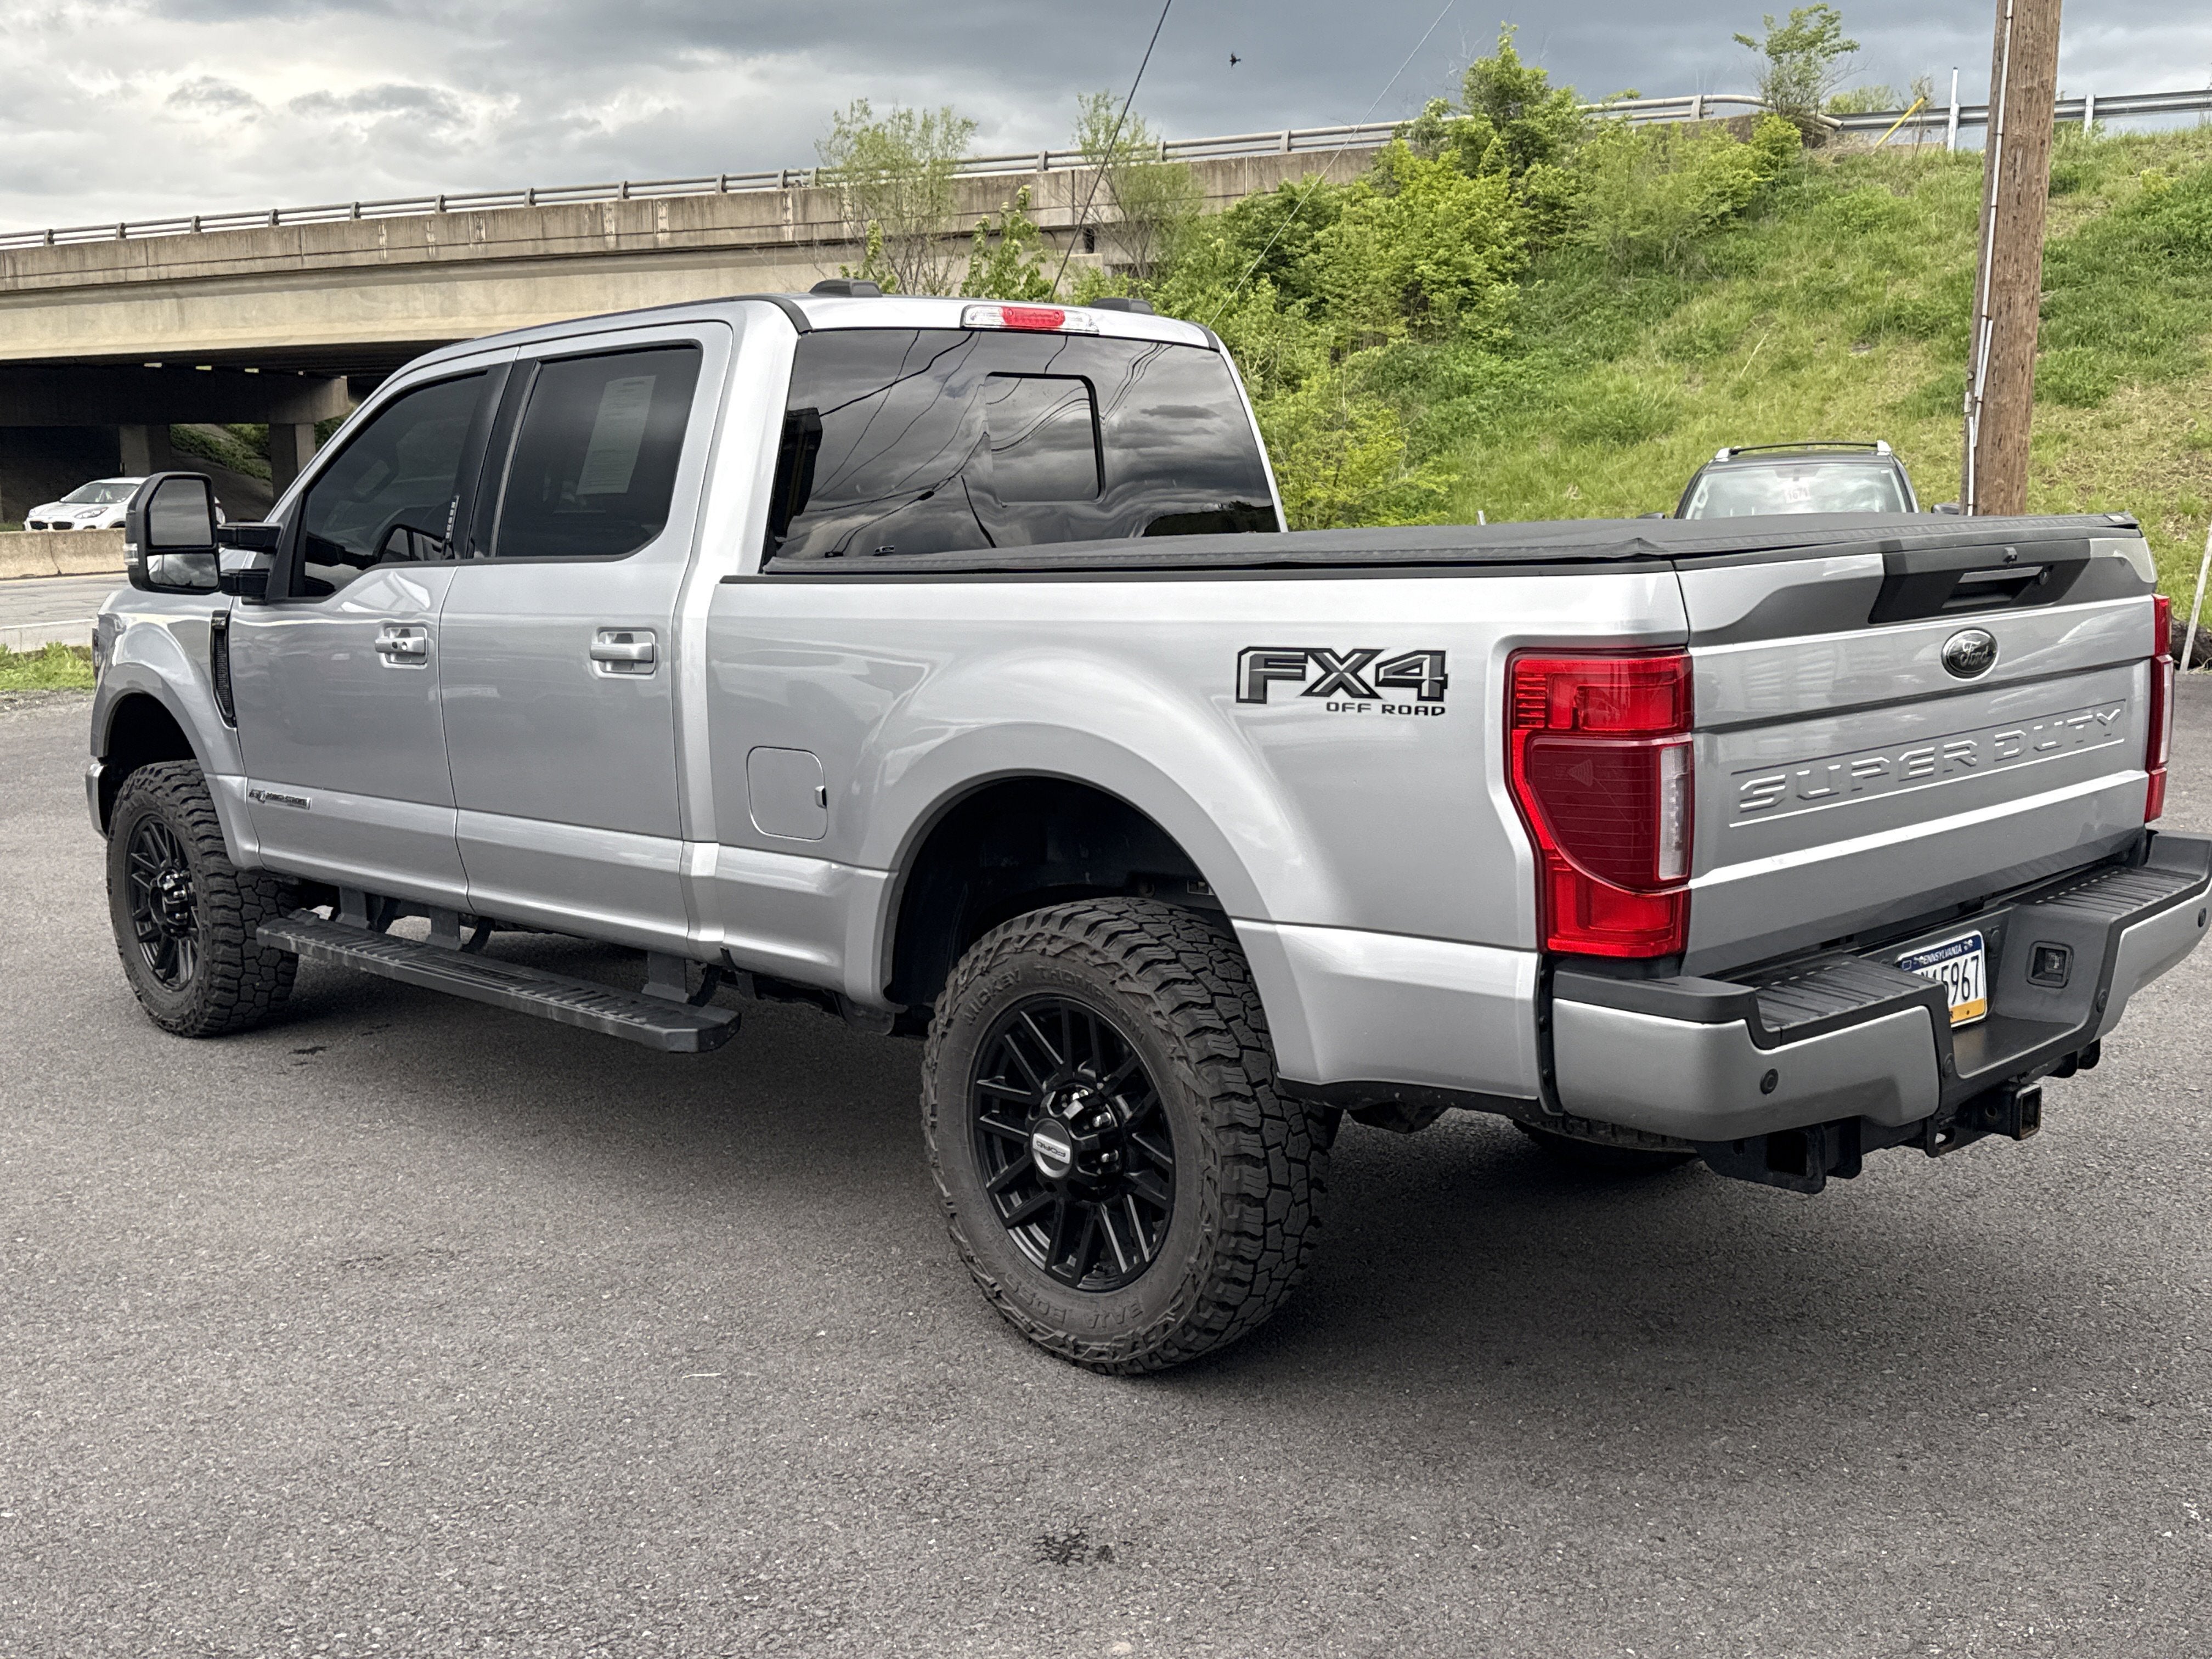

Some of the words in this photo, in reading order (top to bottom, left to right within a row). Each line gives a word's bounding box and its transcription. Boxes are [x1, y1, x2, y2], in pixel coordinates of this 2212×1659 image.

[1957, 639, 1989, 668] Ford
[1235, 646, 1448, 704] FX4
[1326, 702, 1372, 713] OFF
[1381, 704, 1446, 716] ROAD
[1739, 739, 1978, 814] SUPER
[1994, 708, 2121, 762] DUTY
[1919, 944, 1962, 965] ENNSYLVANIA
